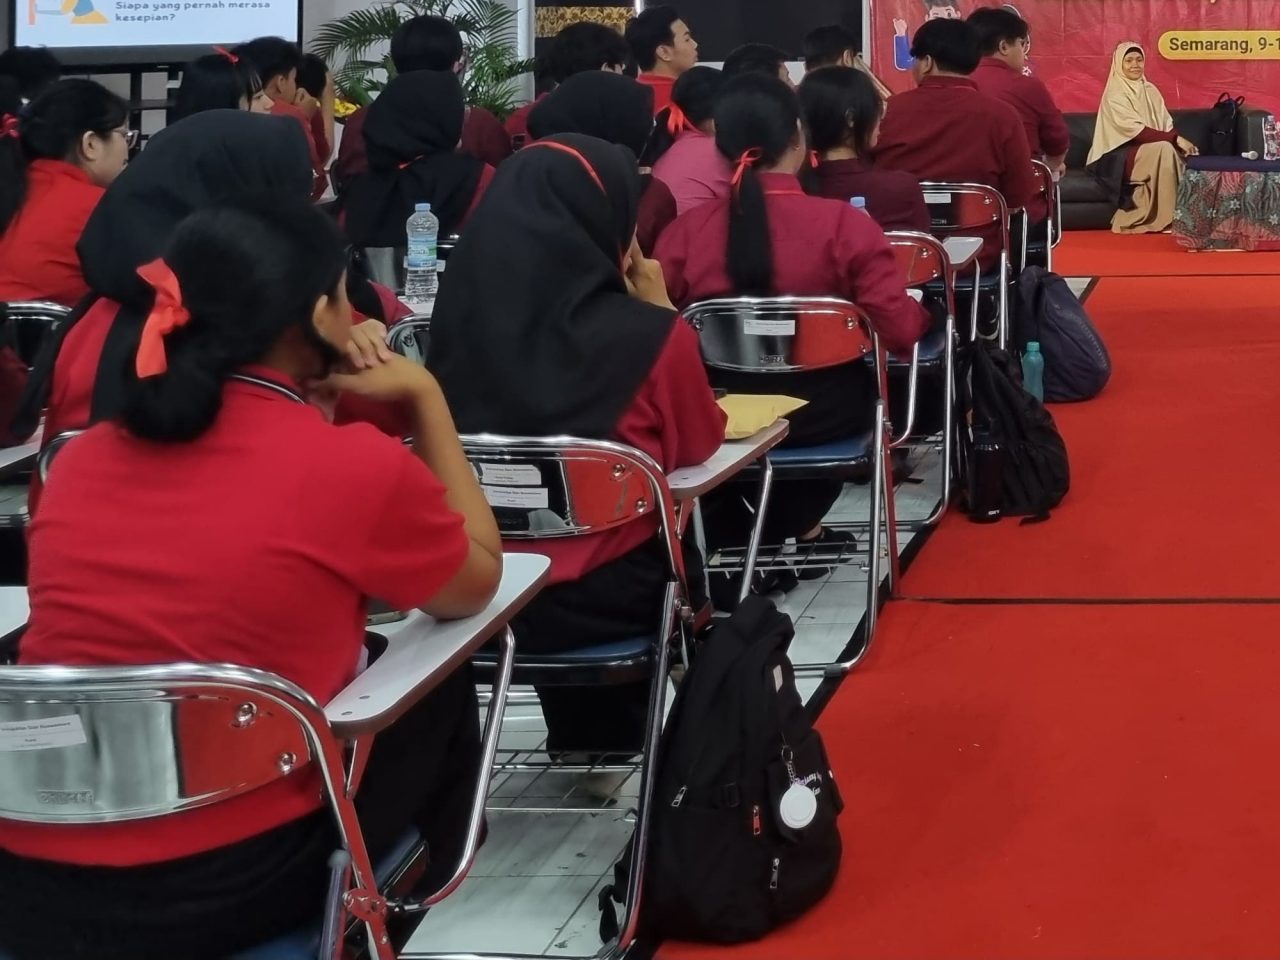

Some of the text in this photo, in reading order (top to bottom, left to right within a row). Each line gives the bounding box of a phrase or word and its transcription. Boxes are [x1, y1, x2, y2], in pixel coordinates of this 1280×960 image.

[115, 0, 270, 11] Siapa yang pernah merasa
[115, 13, 176, 23] kesepian?
[1169, 36, 1254, 54] Semarang,
